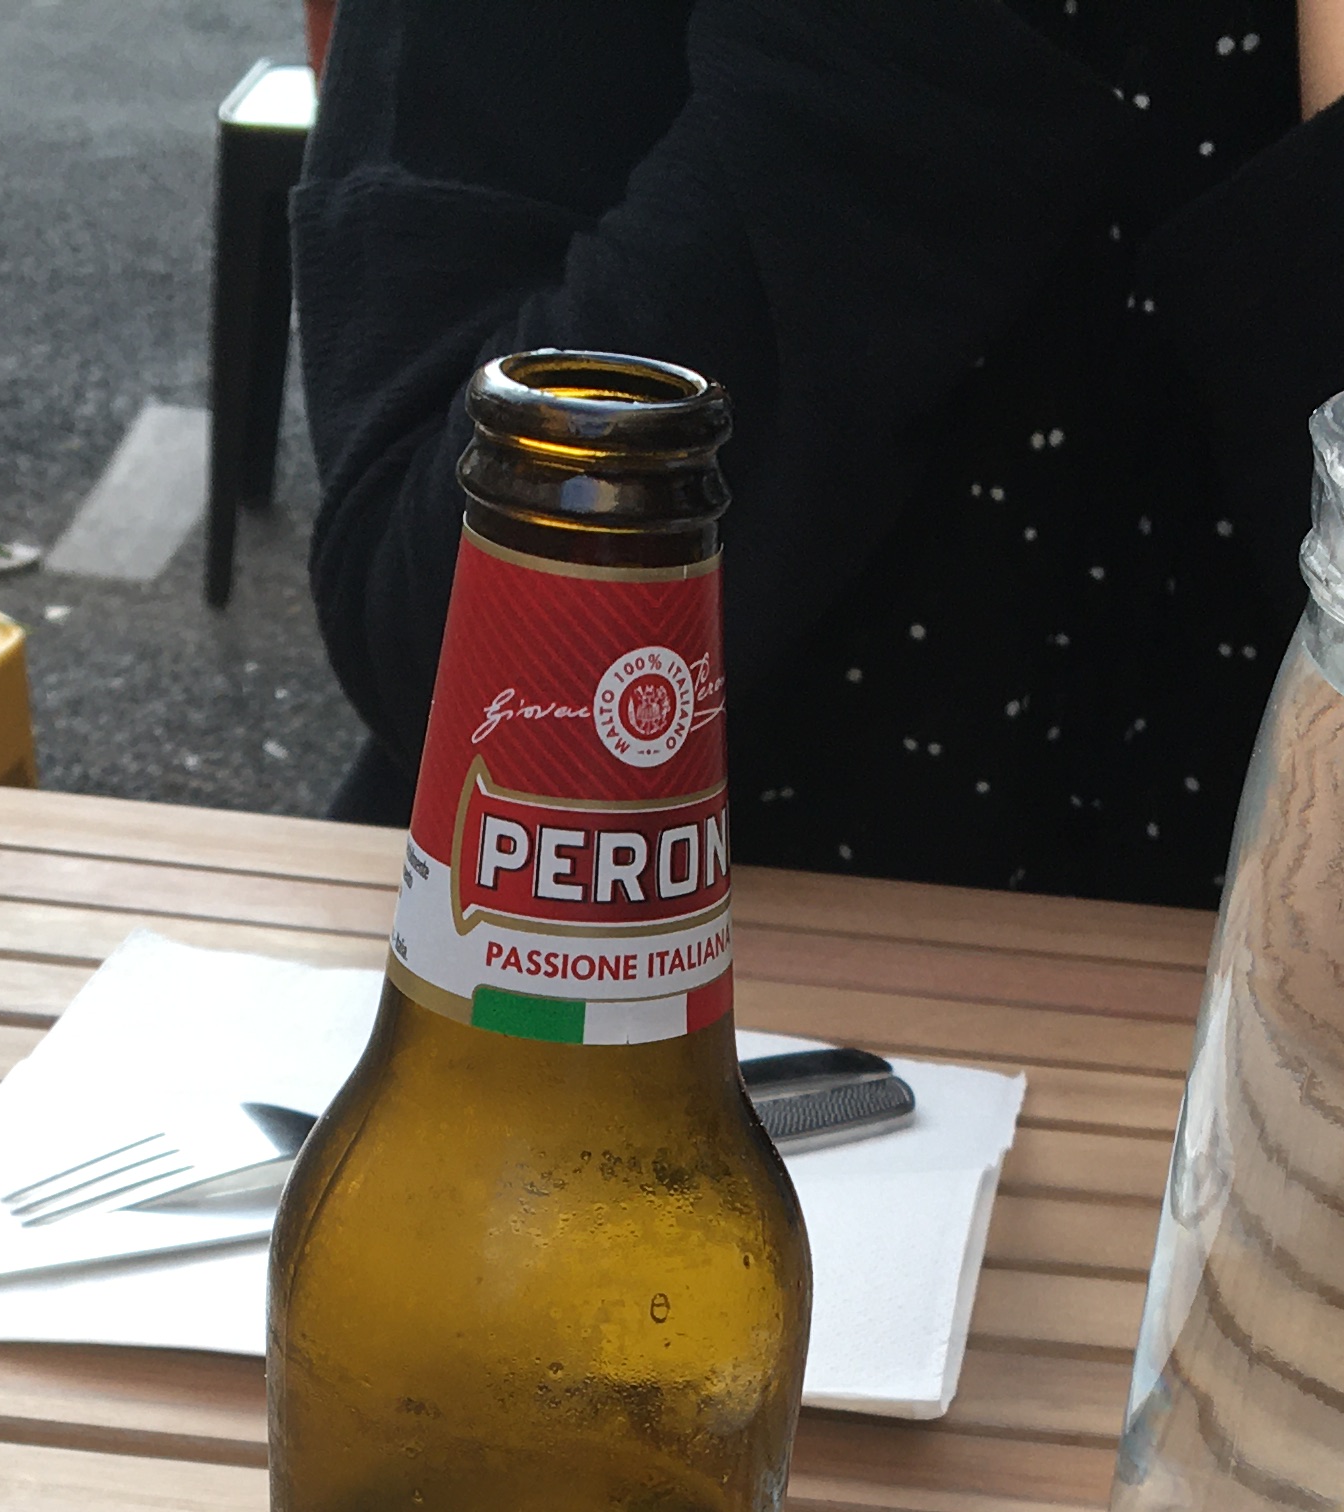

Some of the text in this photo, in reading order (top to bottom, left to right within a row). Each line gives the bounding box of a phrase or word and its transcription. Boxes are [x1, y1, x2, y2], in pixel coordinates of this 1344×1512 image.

[599, 653, 691, 755] MALTO 100% ITALIANO
[485, 923, 731, 981] PASSIONE ITALIANA
